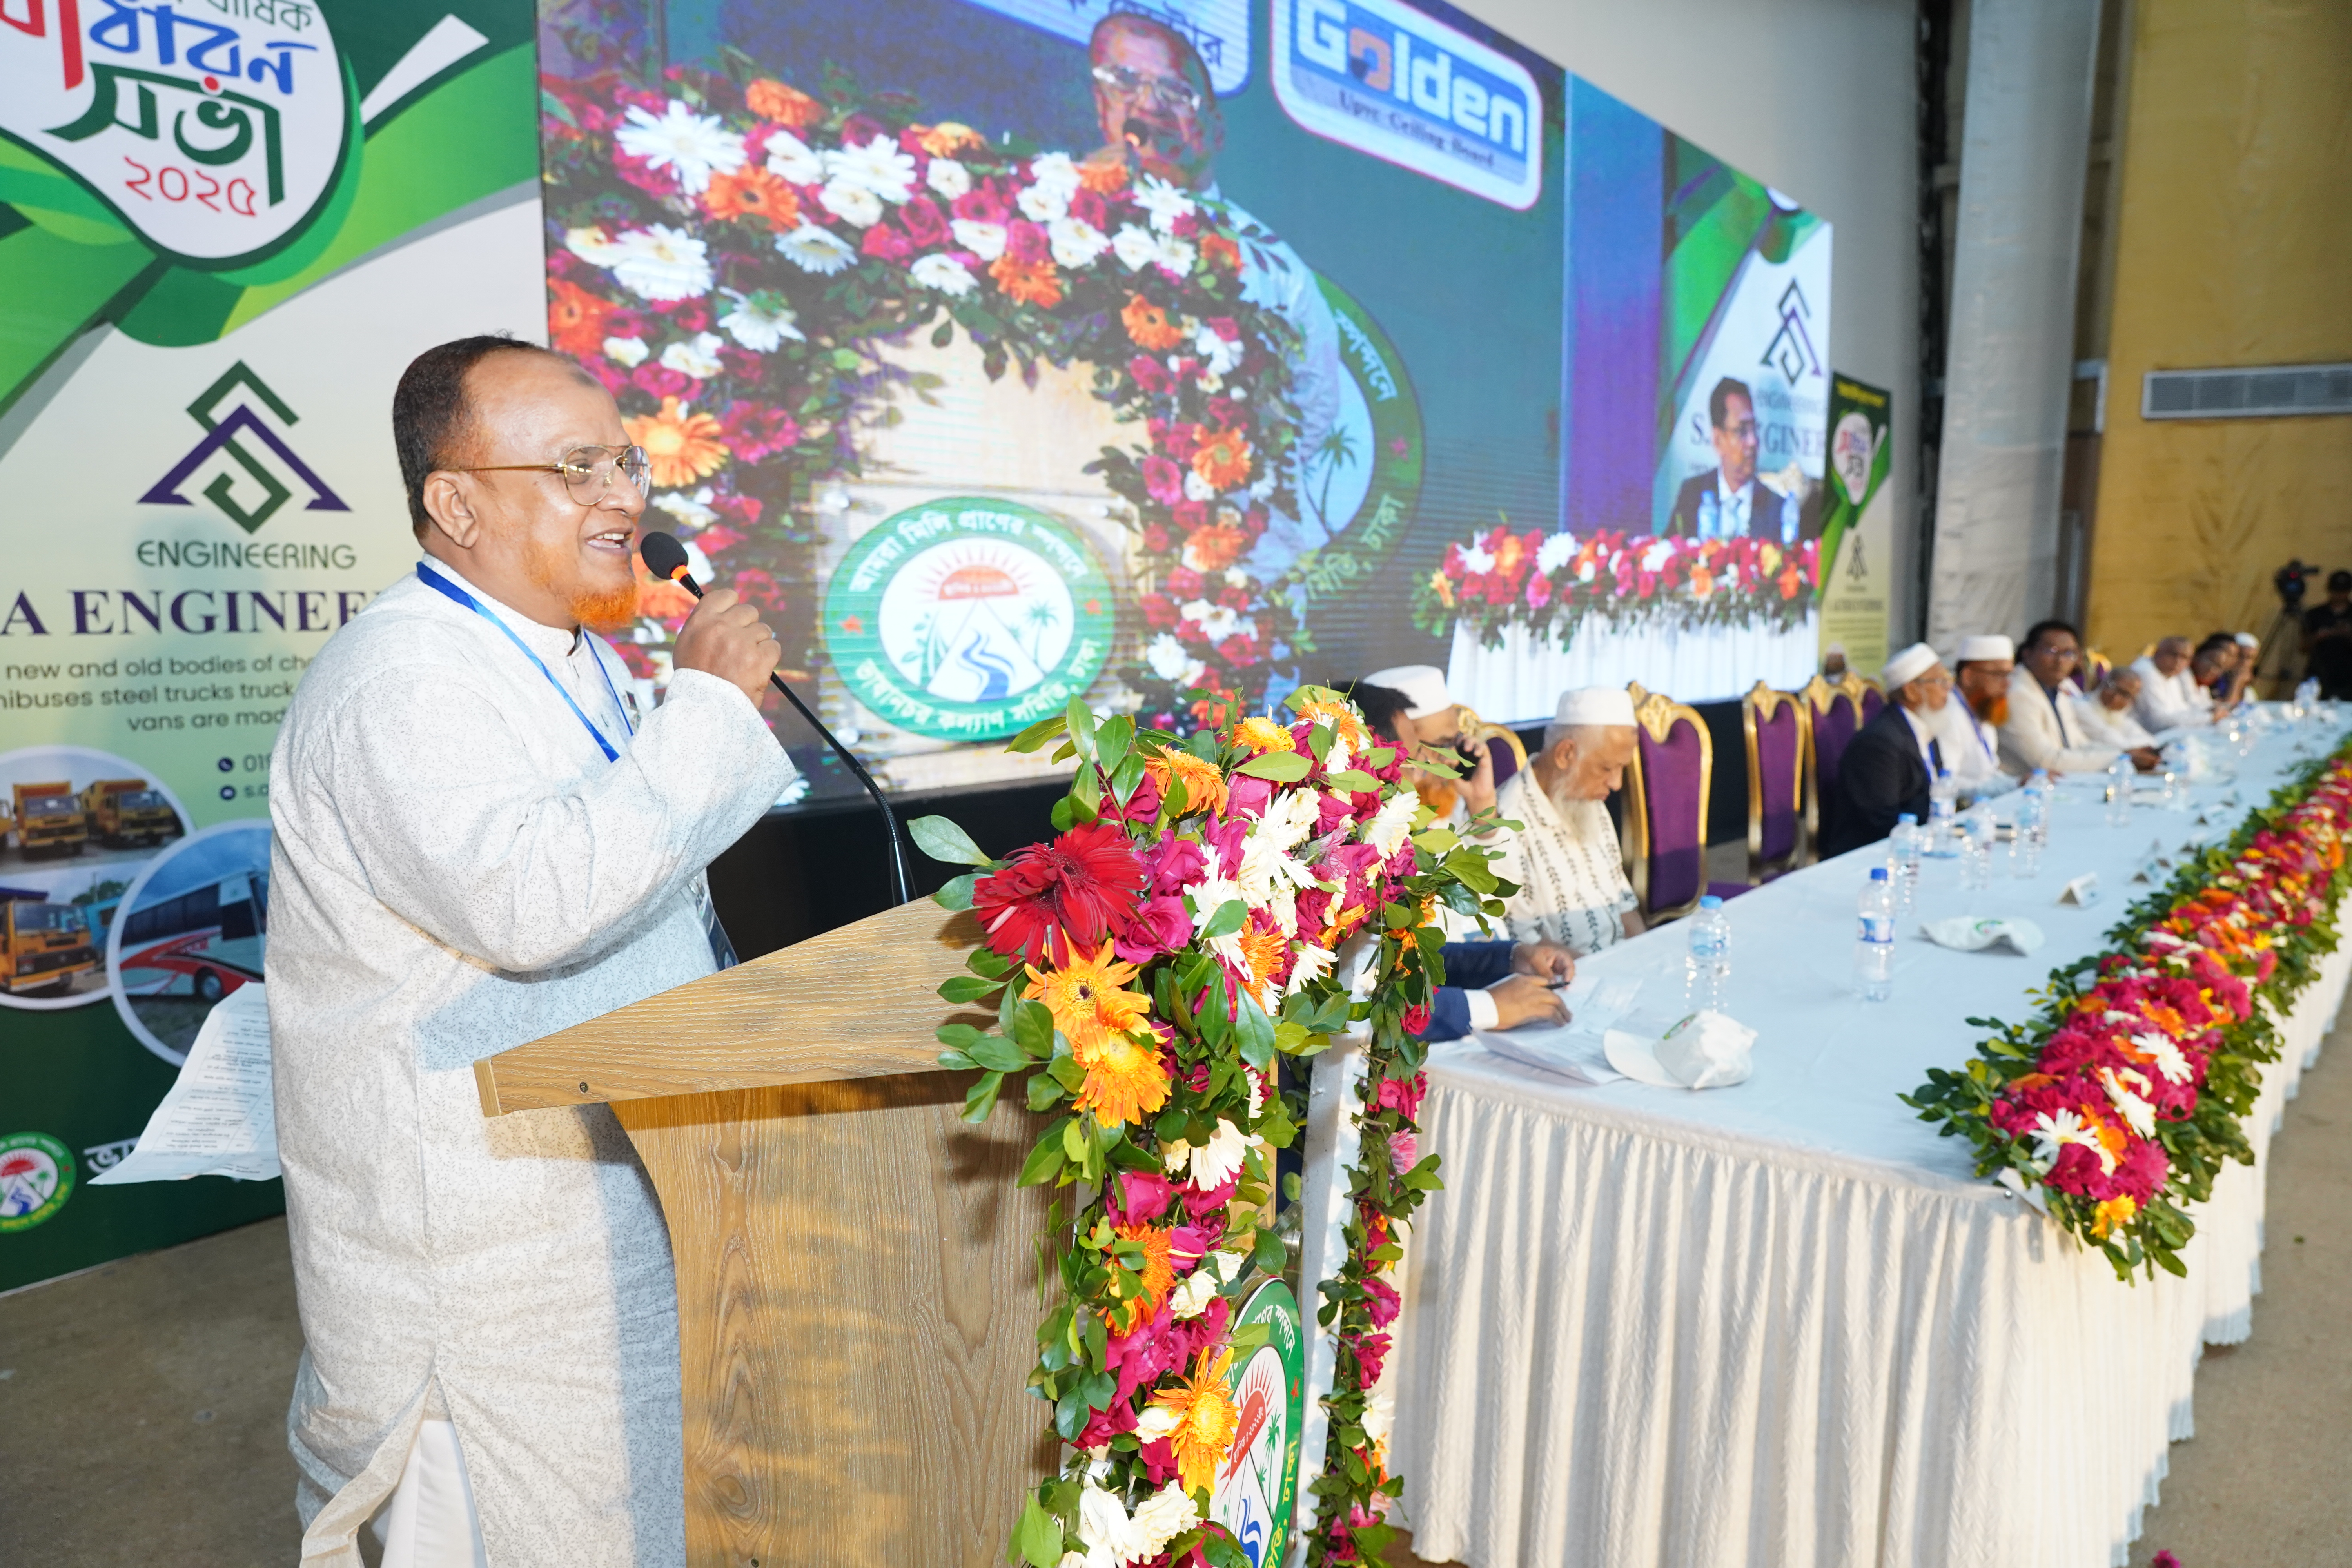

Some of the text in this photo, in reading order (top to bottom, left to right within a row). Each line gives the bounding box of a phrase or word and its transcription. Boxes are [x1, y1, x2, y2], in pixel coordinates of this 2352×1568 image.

[1296, 0, 1525, 153] Golden
[41, 62, 285, 208] সভা
[124, 156, 257, 216] ২০২৫
[137, 540, 356, 569] ENGINEERING
[68, 589, 382, 636] ENGINEE
[7, 664, 60, 679] new
[68, 658, 118, 678] and
[125, 657, 162, 676] old
[170, 656, 246, 675] bodies
[252, 655, 274, 672] of
[101, 686, 157, 705] steel
[165, 683, 234, 703] trucks
[127, 714, 185, 731] vans
[191, 712, 229, 728] are
[1282, 1441, 1297, 1505] ঢাকা
